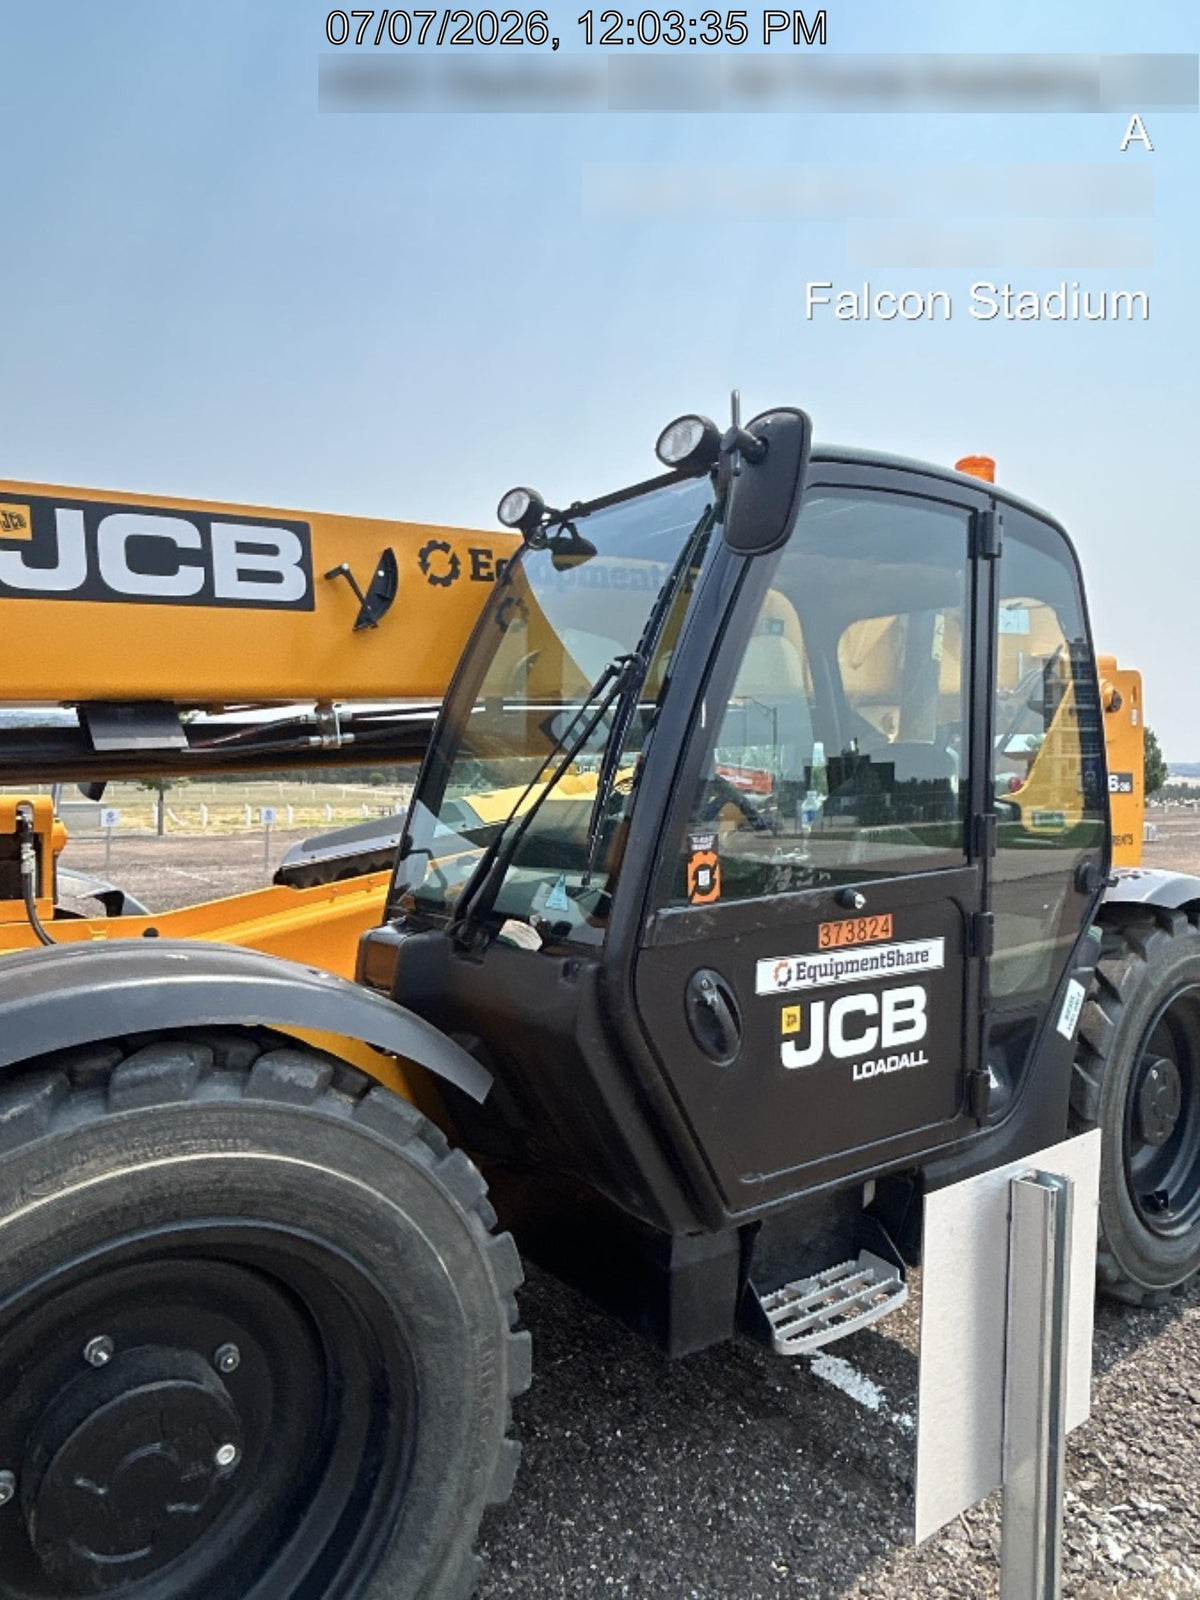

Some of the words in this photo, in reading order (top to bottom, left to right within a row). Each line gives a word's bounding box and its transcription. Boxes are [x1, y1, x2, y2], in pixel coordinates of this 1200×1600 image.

[0, 509, 308, 602] JCB
[820, 917, 891, 947] 373824
[795, 949, 929, 983] EquipmentShare
[780, 985, 928, 1070] JCB
[852, 1051, 929, 1081] LOADALL
